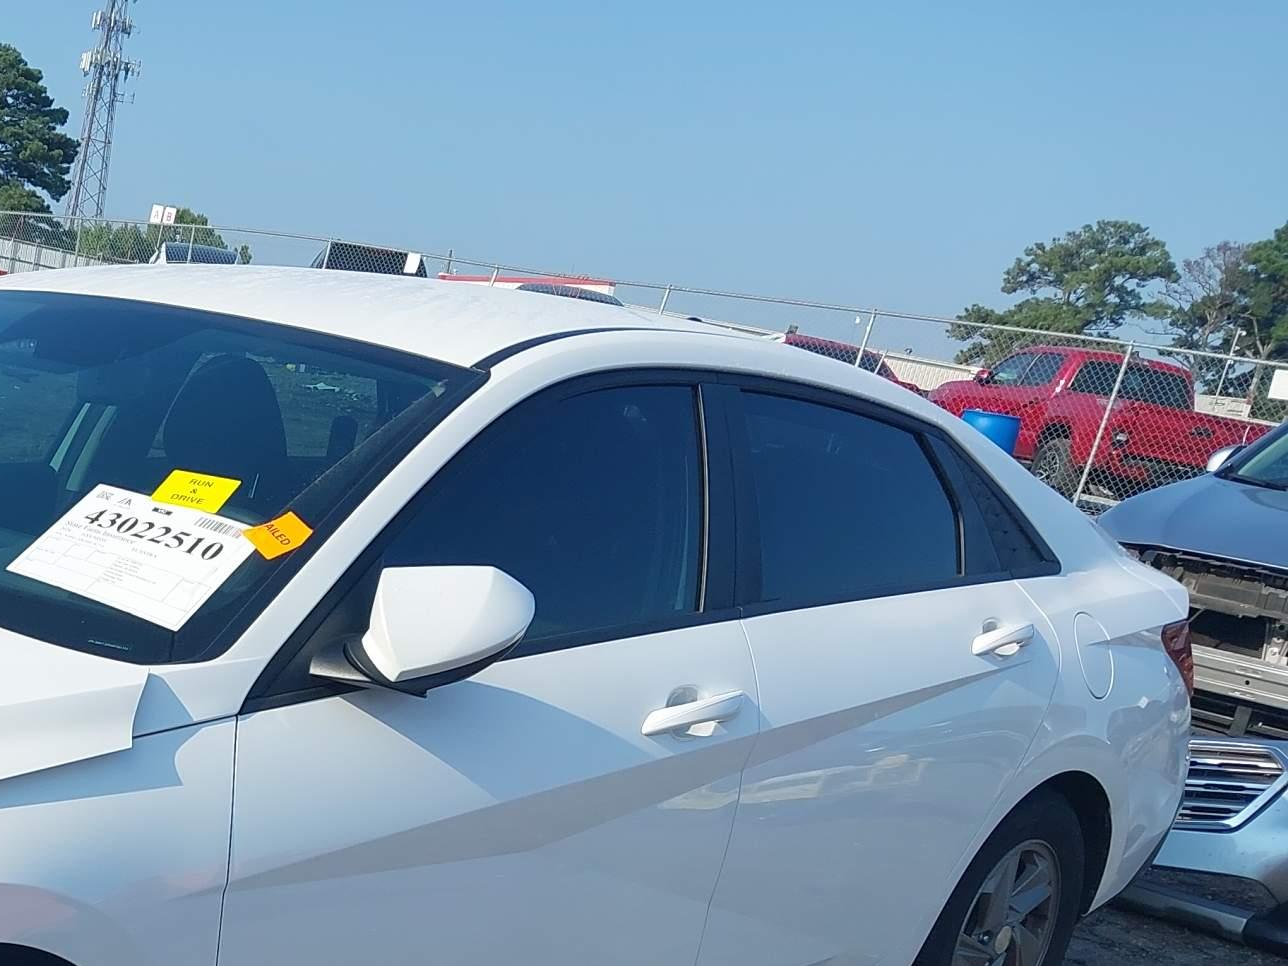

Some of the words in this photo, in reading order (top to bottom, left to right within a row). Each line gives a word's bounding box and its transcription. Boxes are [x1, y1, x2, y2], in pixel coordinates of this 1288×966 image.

[188, 478, 214, 488] RUN
[170, 493, 205, 505] DRIVE
[84, 508, 224, 560] 43022510
[264, 523, 291, 546] AILED
